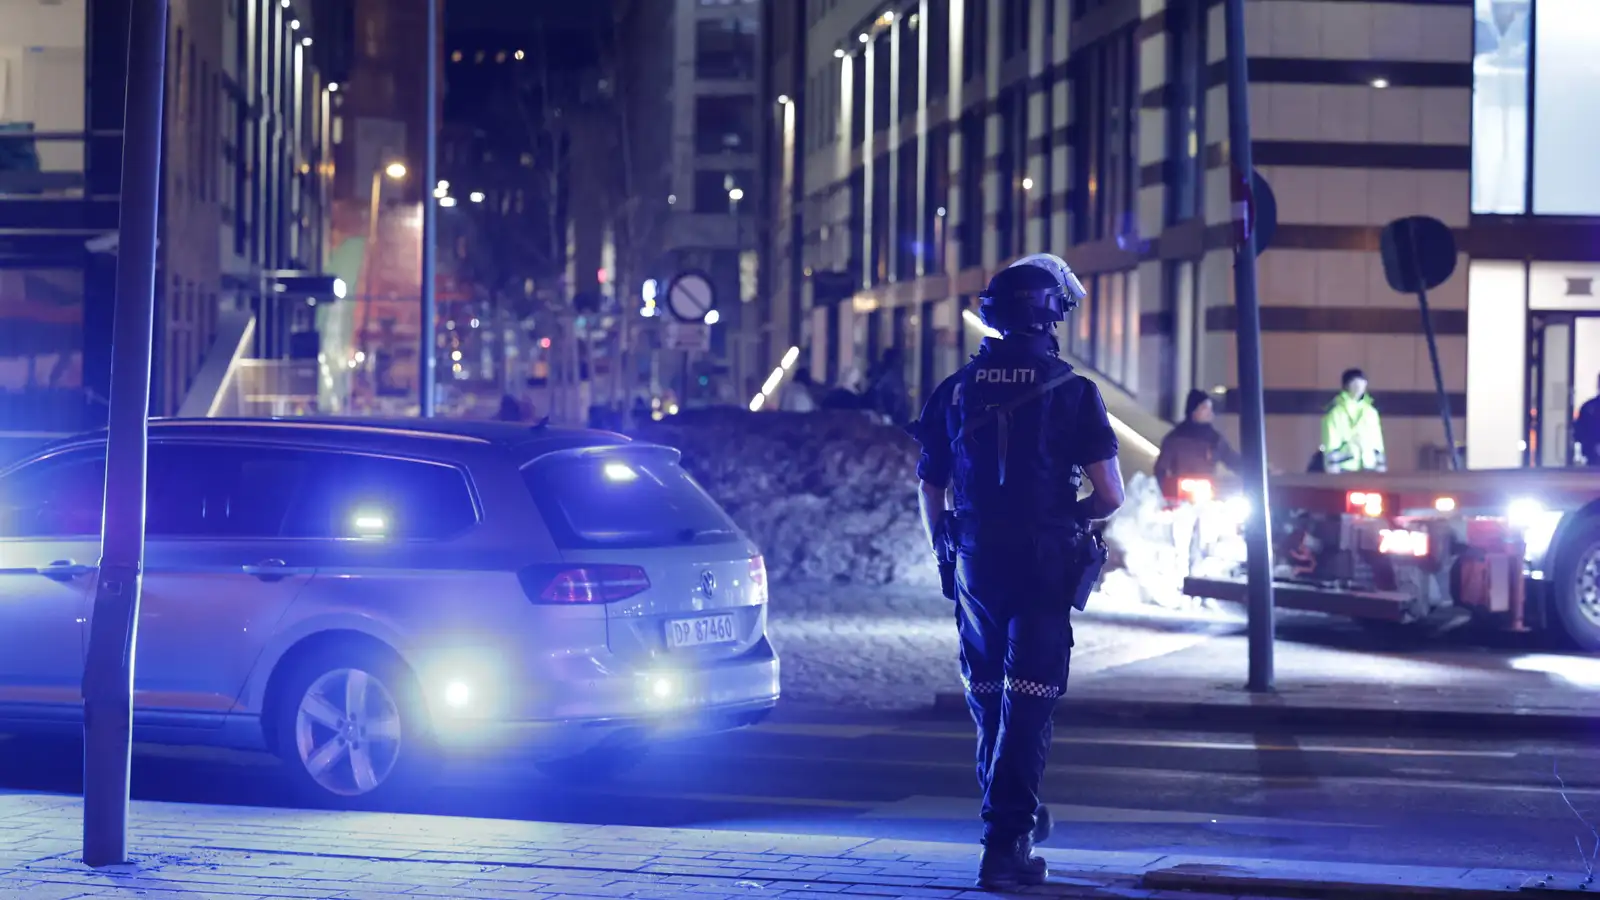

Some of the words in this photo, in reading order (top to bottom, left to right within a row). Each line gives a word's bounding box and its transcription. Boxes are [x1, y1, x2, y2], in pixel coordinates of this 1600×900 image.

[975, 368, 1036, 384] POLITI
[673, 621, 691, 644] DP
[695, 616, 732, 642] 87460
